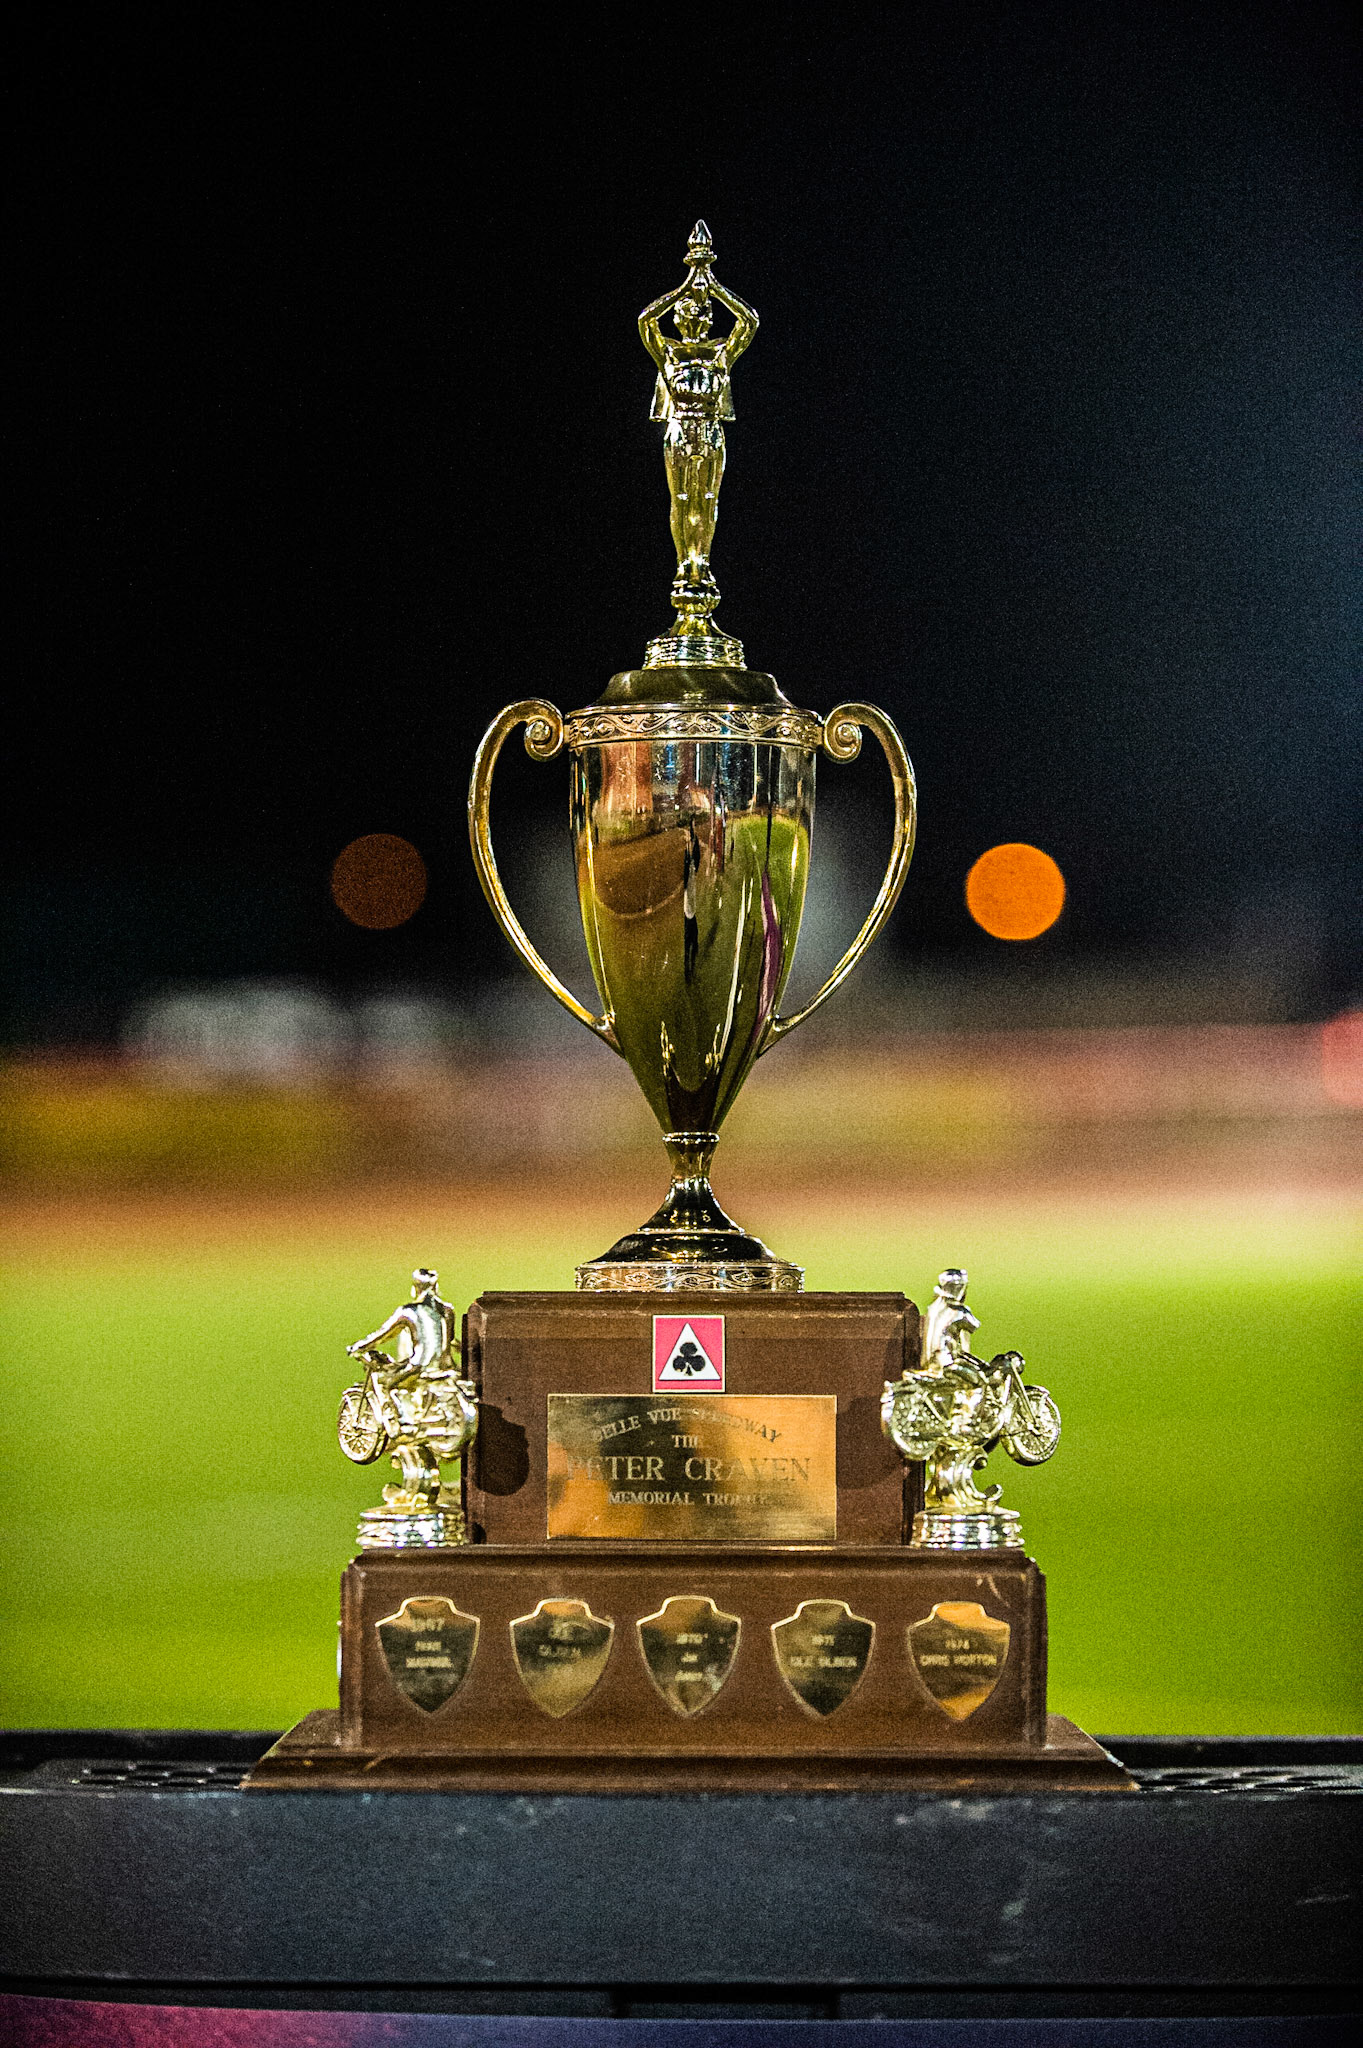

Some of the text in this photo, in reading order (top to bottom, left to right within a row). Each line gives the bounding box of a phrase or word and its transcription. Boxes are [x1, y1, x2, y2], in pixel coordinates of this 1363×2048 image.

[592, 1415, 642, 1442] BELLE
[647, 1407, 682, 1425] VUE
[671, 1434, 703, 1448] THE
[566, 1456, 810, 1481] PETER CRAVEN
[608, 1491, 768, 1506] MEMORIAL TROPHY
